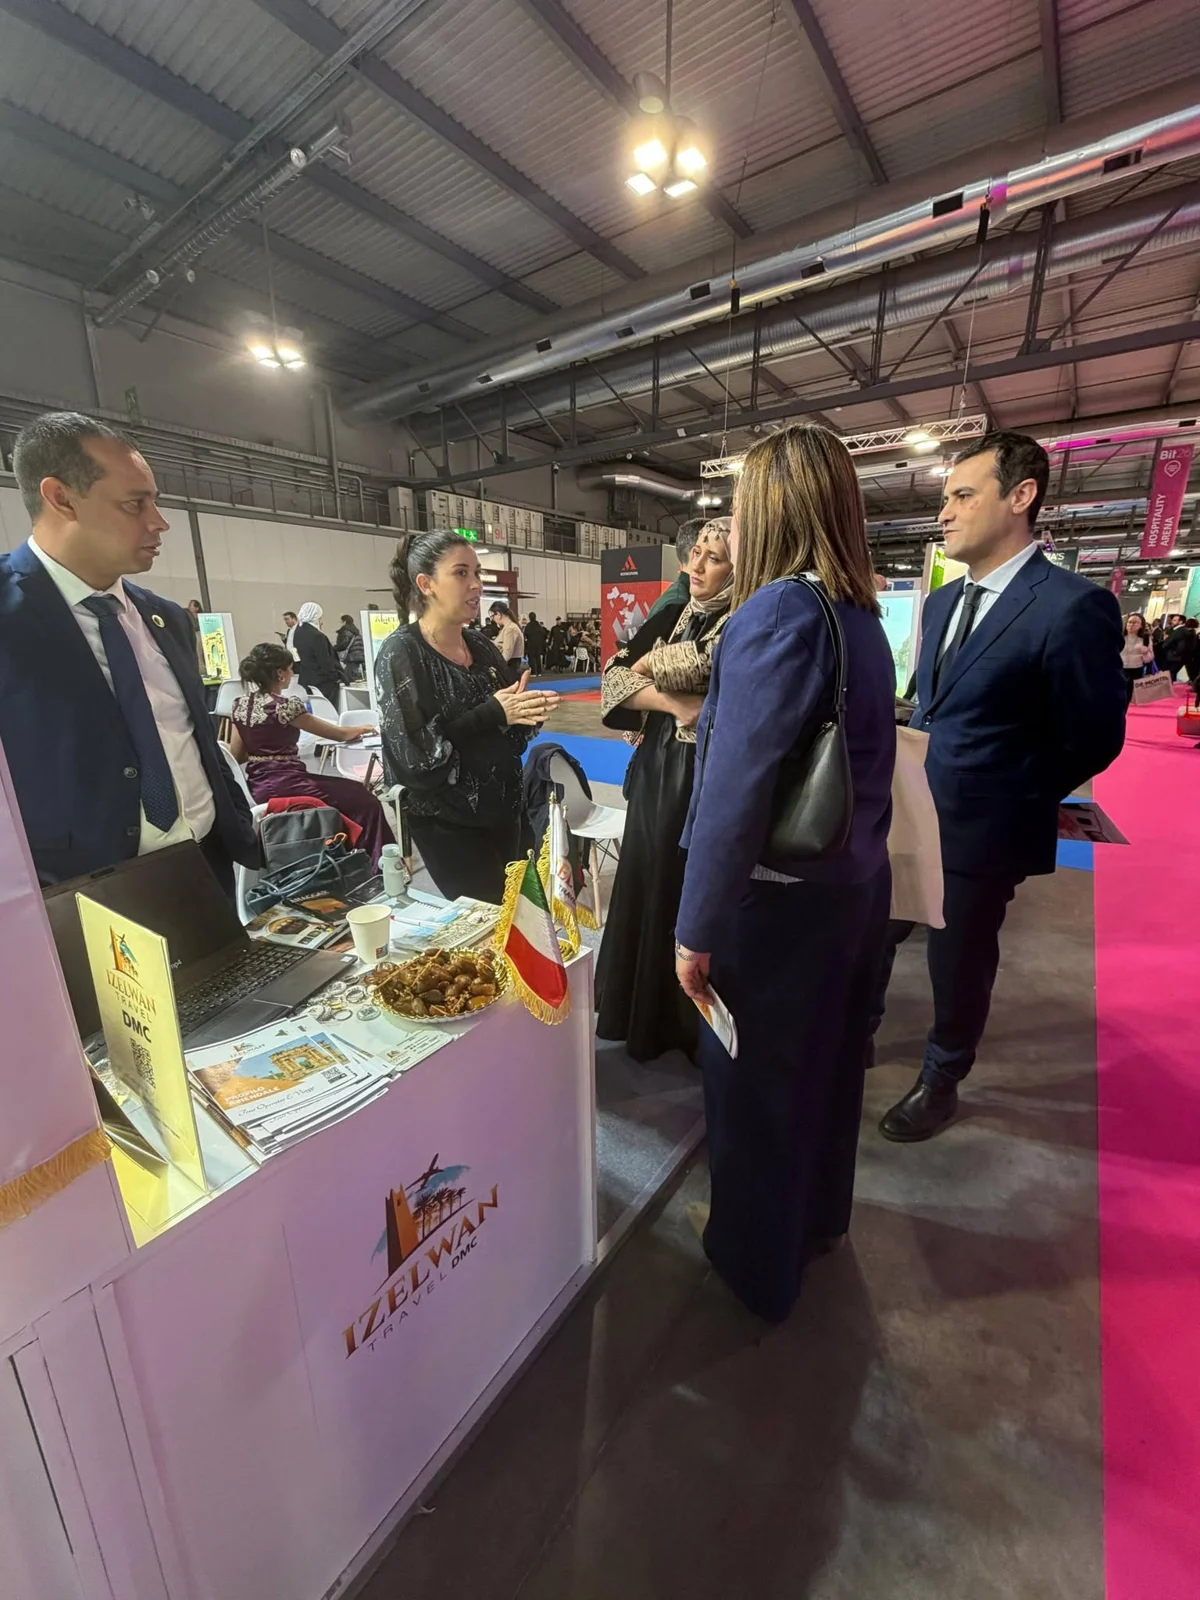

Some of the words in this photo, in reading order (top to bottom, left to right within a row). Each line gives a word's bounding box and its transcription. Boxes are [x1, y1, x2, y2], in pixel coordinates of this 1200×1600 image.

[494, 528, 505, 540] 9L
[1148, 494, 1167, 547] HOSPITALITY
[1160, 516, 1175, 547] ARENA
[106, 969, 157, 1016] IZELWAN
[115, 991, 153, 1023] TRAVEL
[122, 1009, 152, 1043] DMC
[451, 1236, 479, 1270] DMC
[341, 1183, 498, 1360] IZELWAN
[368, 1272, 448, 1351] TRAVEL
